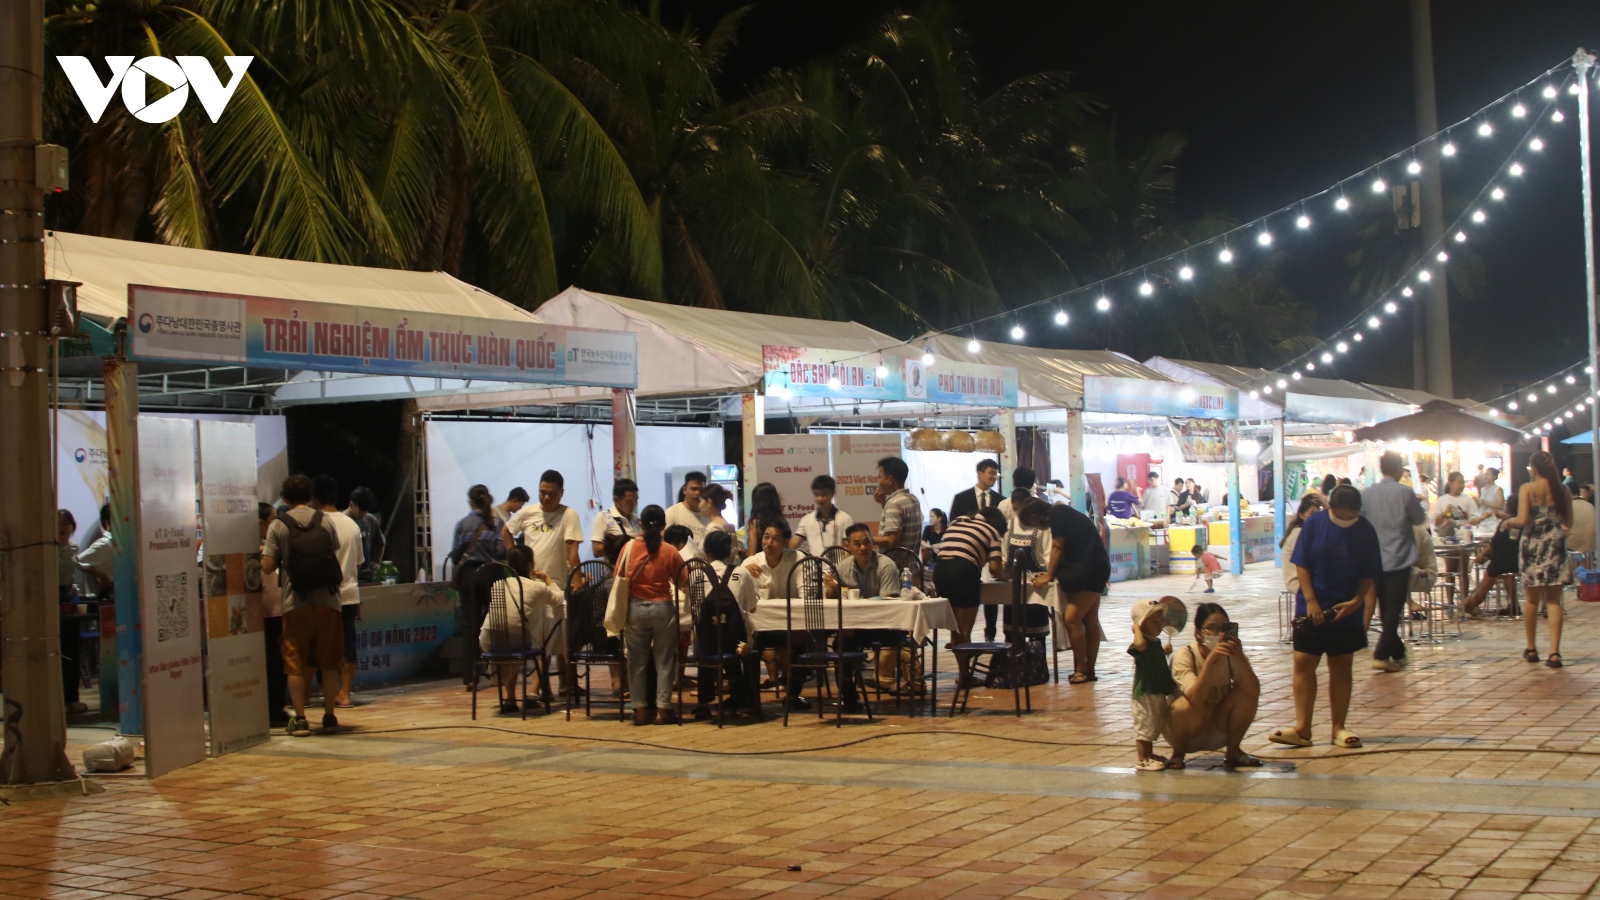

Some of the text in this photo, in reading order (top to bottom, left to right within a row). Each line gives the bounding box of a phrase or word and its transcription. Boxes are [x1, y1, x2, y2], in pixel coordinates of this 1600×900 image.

[263, 309, 556, 371] TRẢI NGHIỆM ẨM THỰC HÀN QUỐC
[567, 348, 579, 362] aT
[851, 366, 864, 387] AN
[793, 465, 812, 473] Now!
[836, 475, 852, 484] 2023
[853, 475, 867, 484] Viet
[845, 486, 864, 496] FOOD
[149, 539, 178, 551] Promotion
[413, 625, 437, 643] 2023
